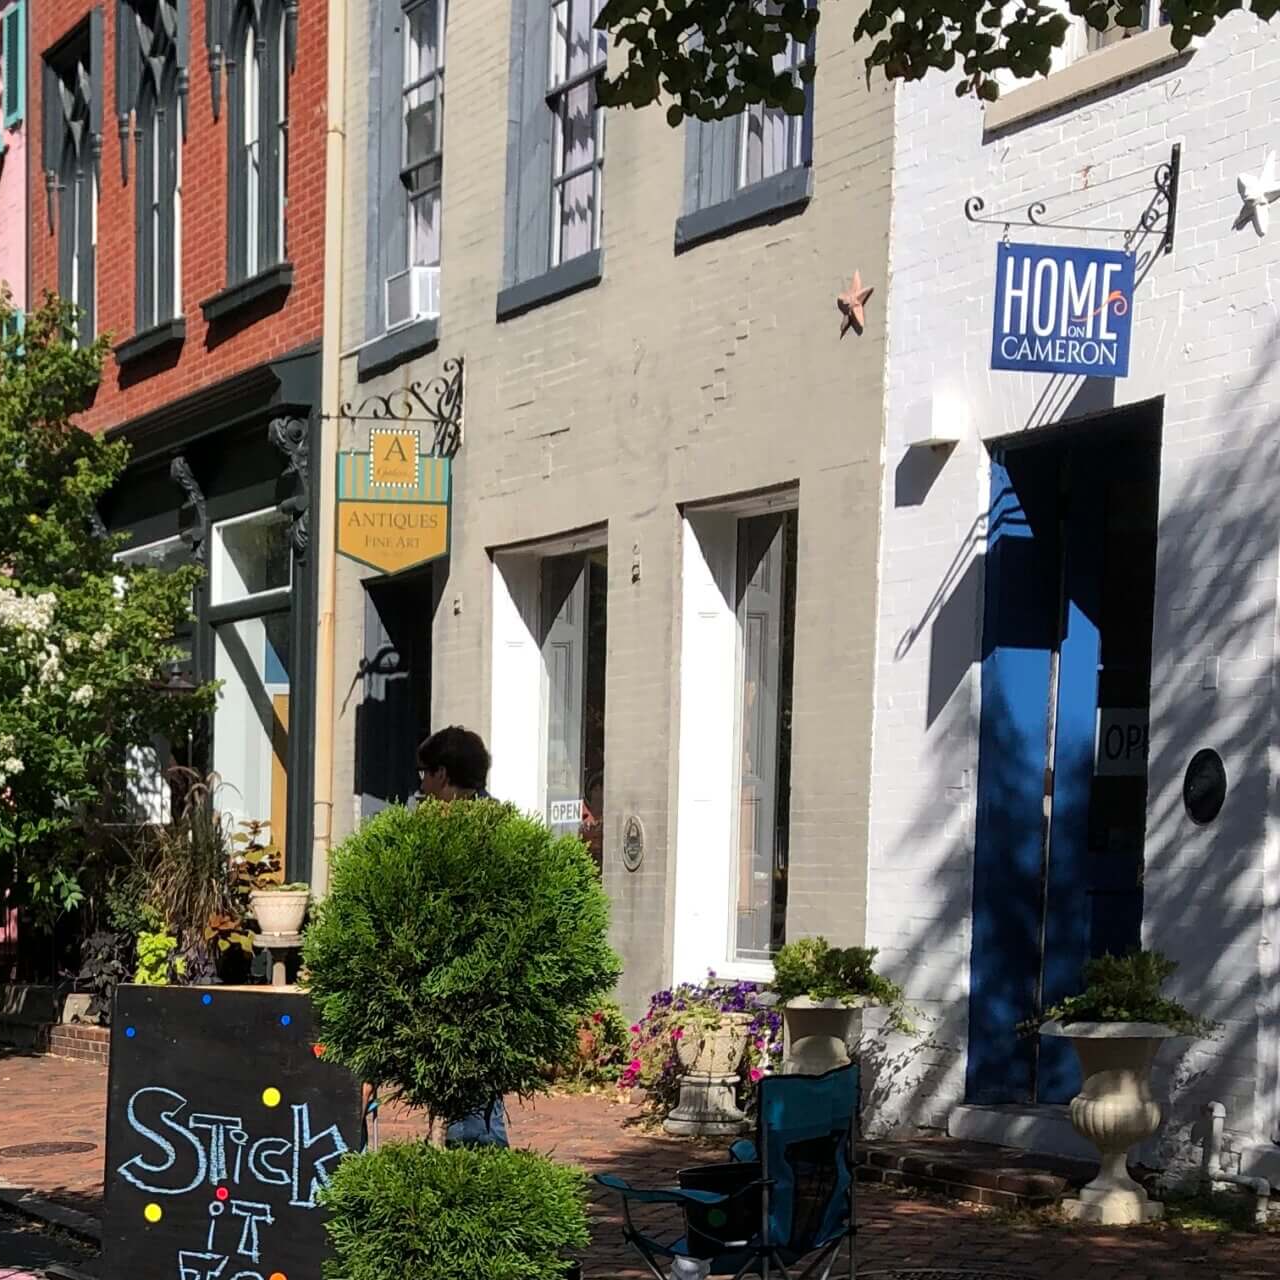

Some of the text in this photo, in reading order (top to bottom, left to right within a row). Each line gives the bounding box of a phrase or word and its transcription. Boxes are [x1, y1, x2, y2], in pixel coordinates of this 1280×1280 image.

[1003, 256, 1123, 340] HOME
[1067, 326, 1085, 338] ON
[1001, 336, 1117, 366] CAMERON
[383, 436, 408, 462] A
[347, 511, 439, 529] ANTIQUES
[365, 534, 421, 549] FINE ART
[1105, 723, 1149, 760] OP
[552, 802, 581, 821] OPEN
